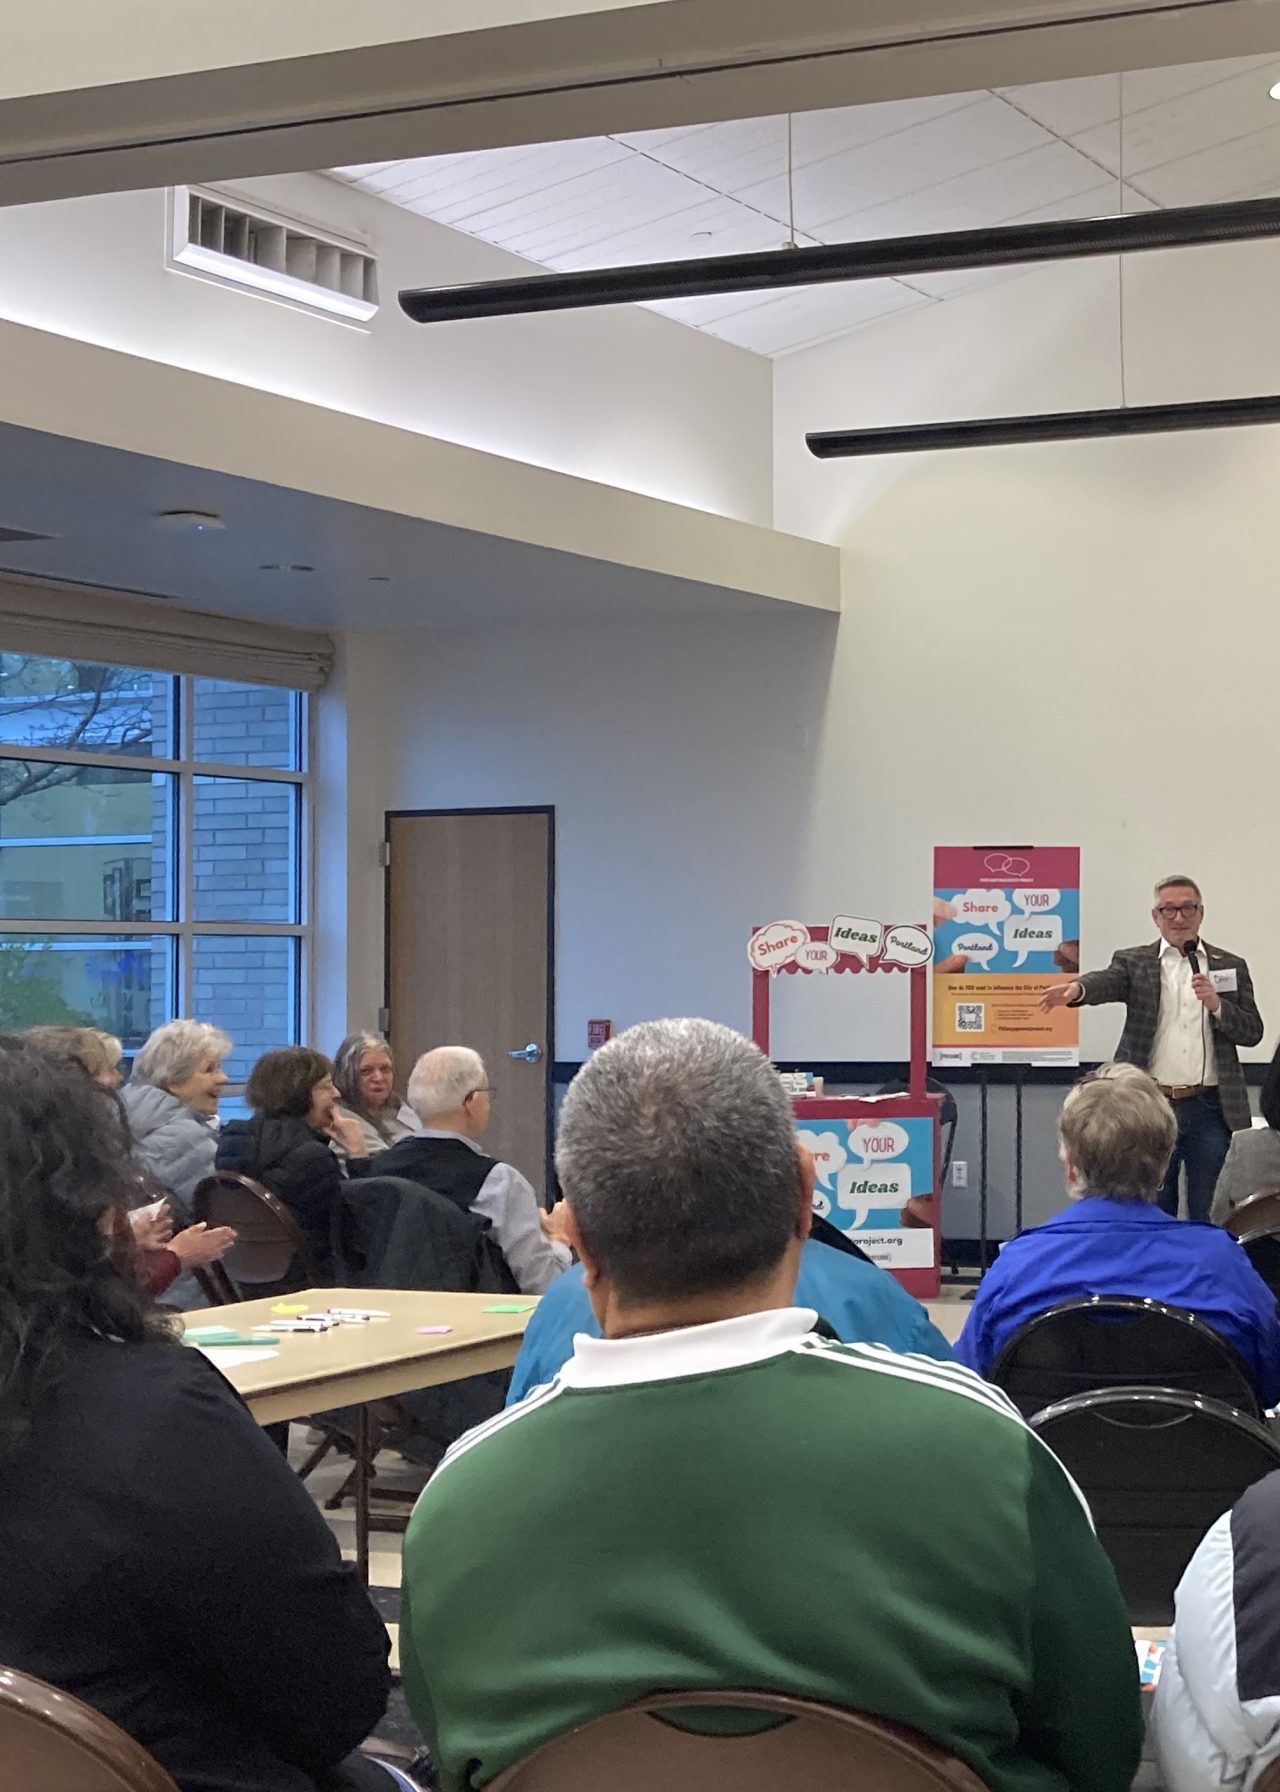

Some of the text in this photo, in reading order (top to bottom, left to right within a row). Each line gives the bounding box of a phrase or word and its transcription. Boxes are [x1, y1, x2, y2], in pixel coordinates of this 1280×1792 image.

[1024, 894, 1049, 906] YOUR
[962, 902, 999, 913] Share
[1013, 928, 1053, 939] Ideas
[758, 927, 928, 961] Share YOUR Ideas Portland
[957, 943, 993, 951] Portland
[862, 1137, 895, 1153] YOUR
[849, 1181, 900, 1194] Ideas
[850, 1236, 903, 1247] project.org
